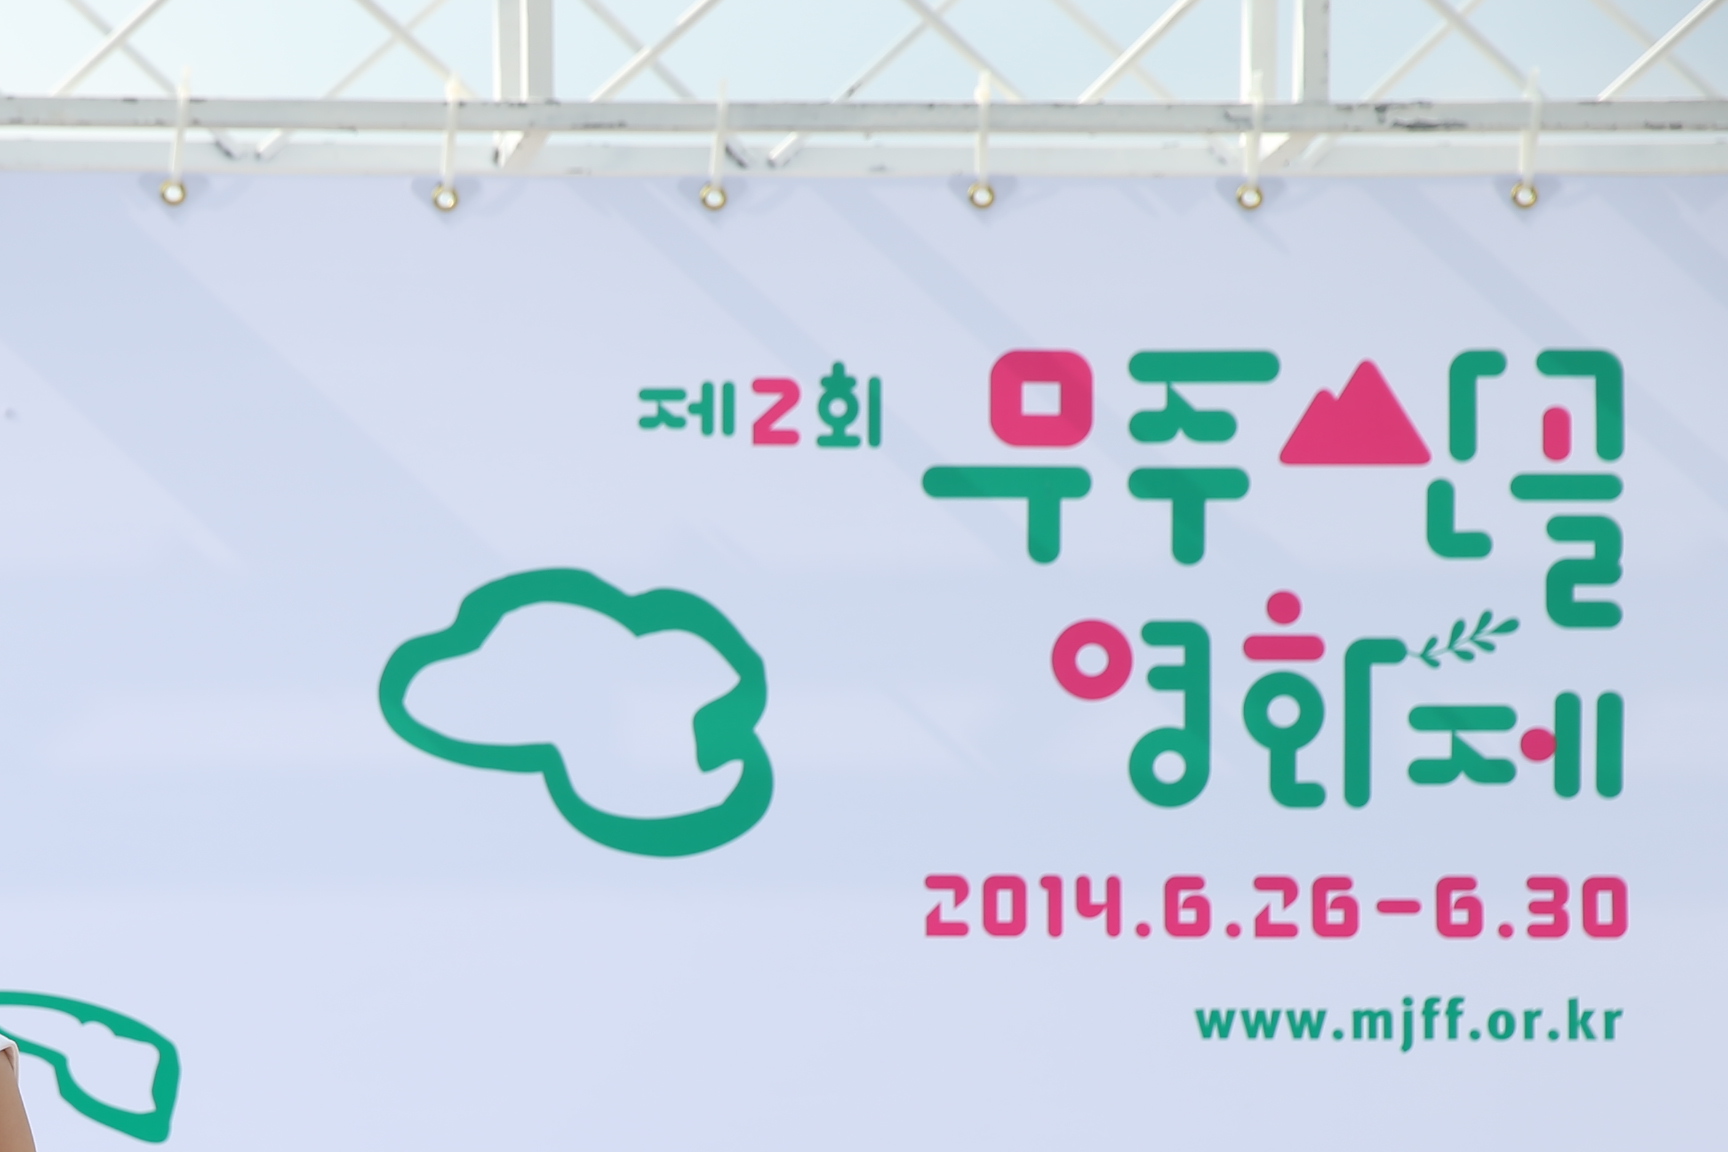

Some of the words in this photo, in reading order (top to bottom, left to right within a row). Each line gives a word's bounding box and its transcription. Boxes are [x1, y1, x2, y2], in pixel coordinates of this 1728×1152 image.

[638, 362, 883, 450] 제2회
[1051, 590, 1625, 810] 영화제
[924, 873, 1630, 940] 2014.6.26-6.30
[1195, 996, 1624, 1053] www.mjff.or.kr
